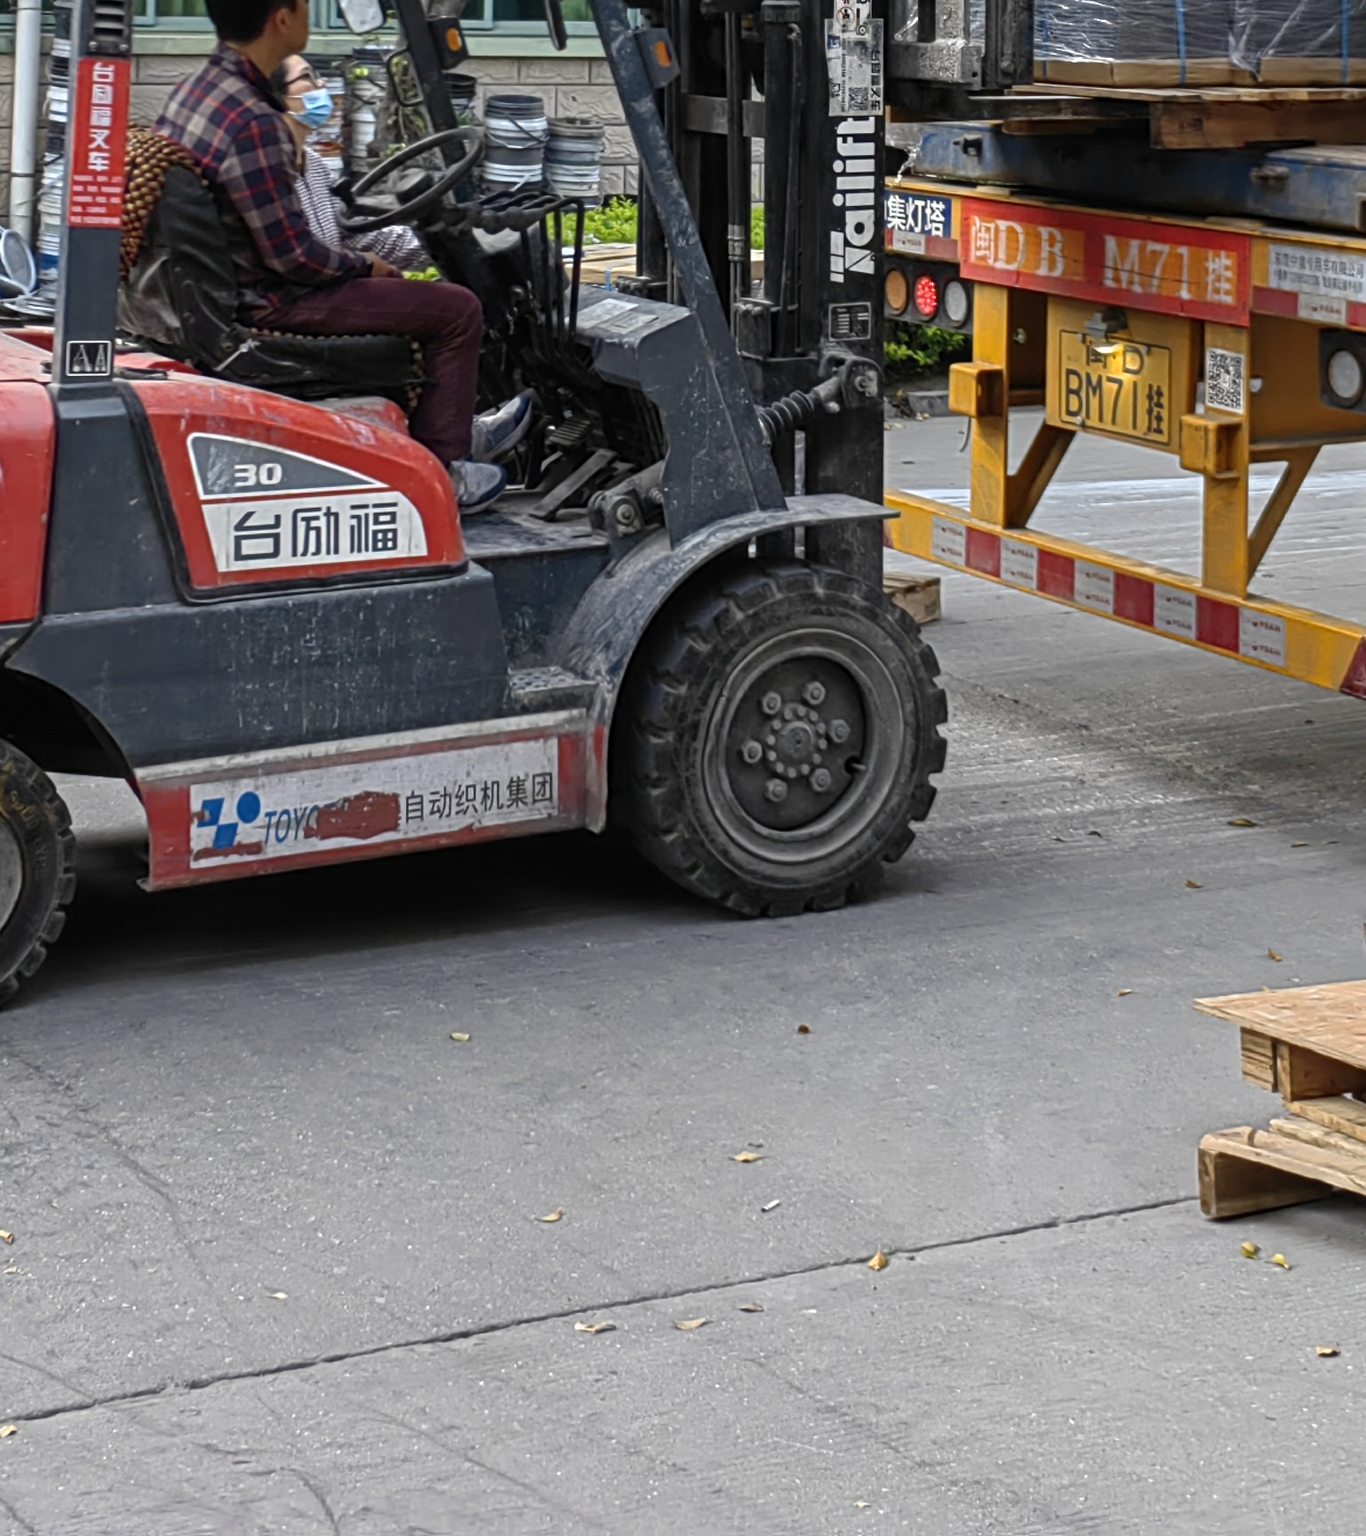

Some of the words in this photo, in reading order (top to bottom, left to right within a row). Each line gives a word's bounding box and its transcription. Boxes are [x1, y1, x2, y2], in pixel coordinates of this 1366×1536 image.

[830, 116, 875, 283] Tailift
[884, 194, 946, 239] 集灯塔
[234, 463, 283, 487] 30
[234, 502, 398, 562] 台励福
[404, 772, 553, 824] 自动织机集团
